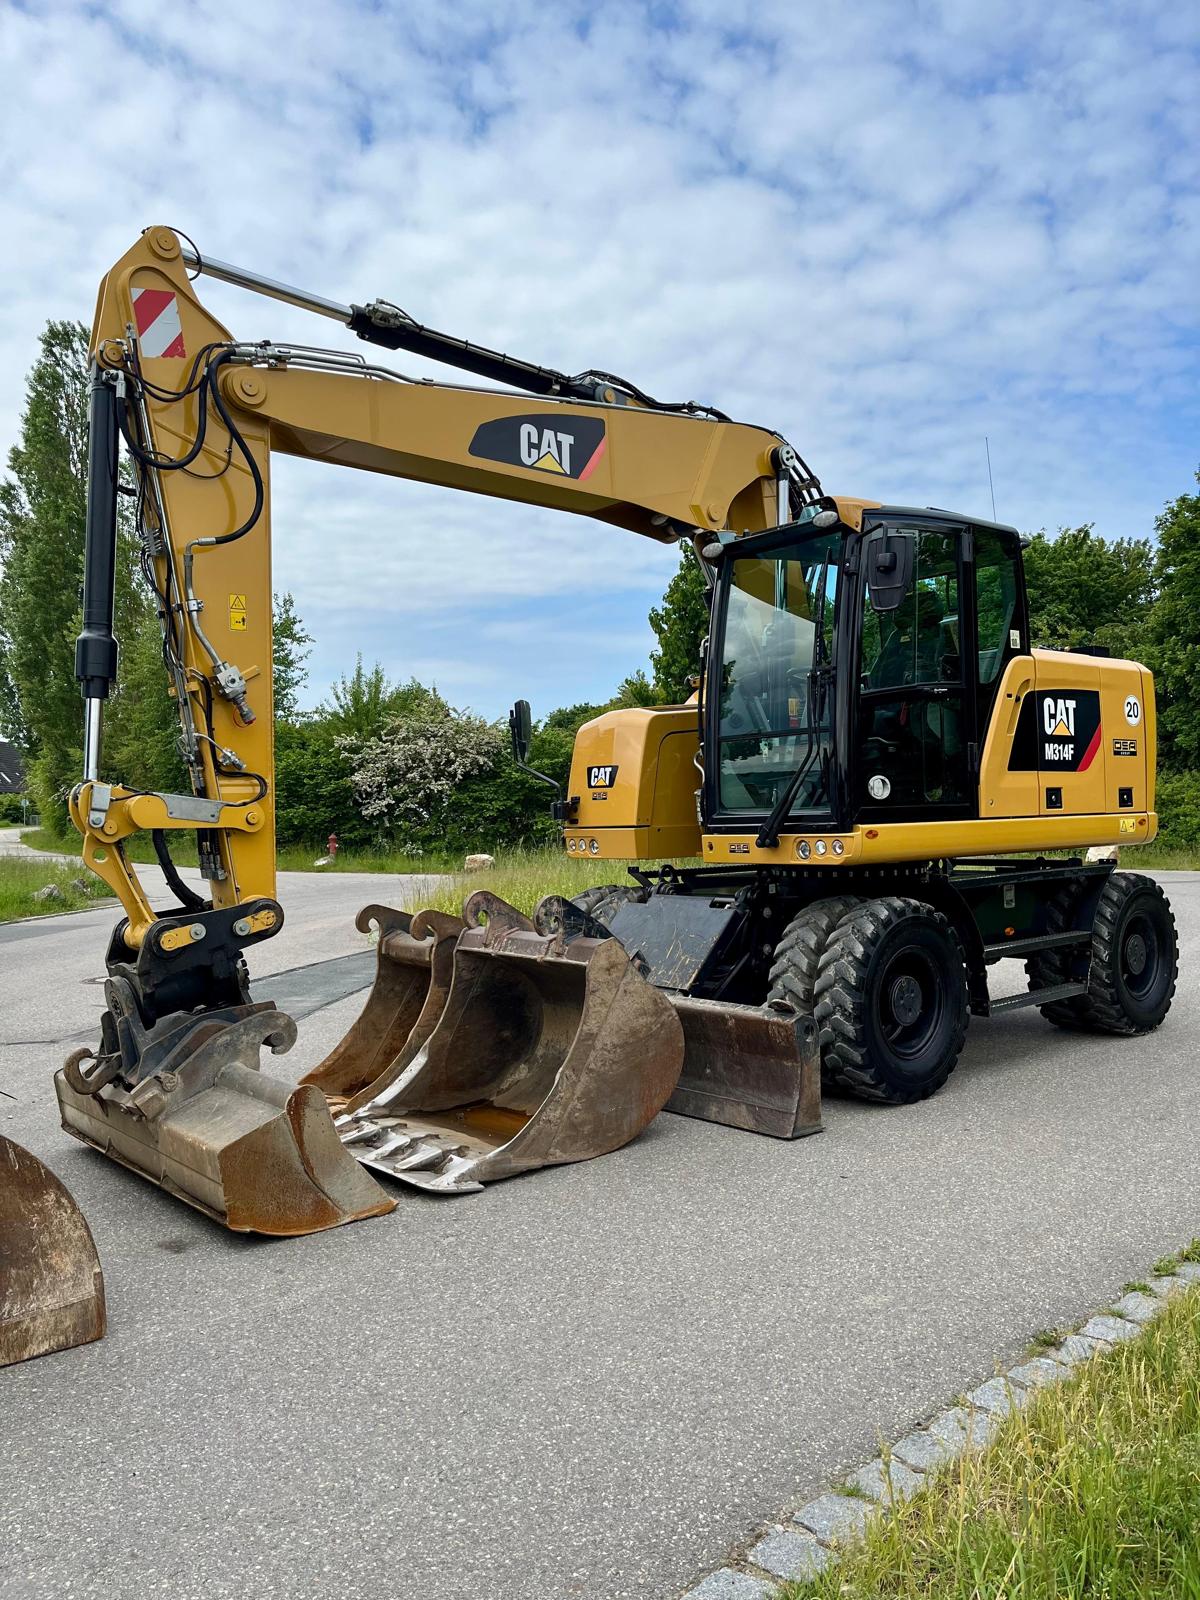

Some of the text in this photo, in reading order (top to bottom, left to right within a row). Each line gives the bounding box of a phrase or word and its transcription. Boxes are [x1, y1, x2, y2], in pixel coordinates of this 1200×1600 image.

[520, 423, 575, 475] CAT
[1043, 697, 1077, 737] CAT
[1126, 701, 1139, 718] 20
[1044, 743, 1075, 761] M314F
[590, 767, 612, 787] CAT
